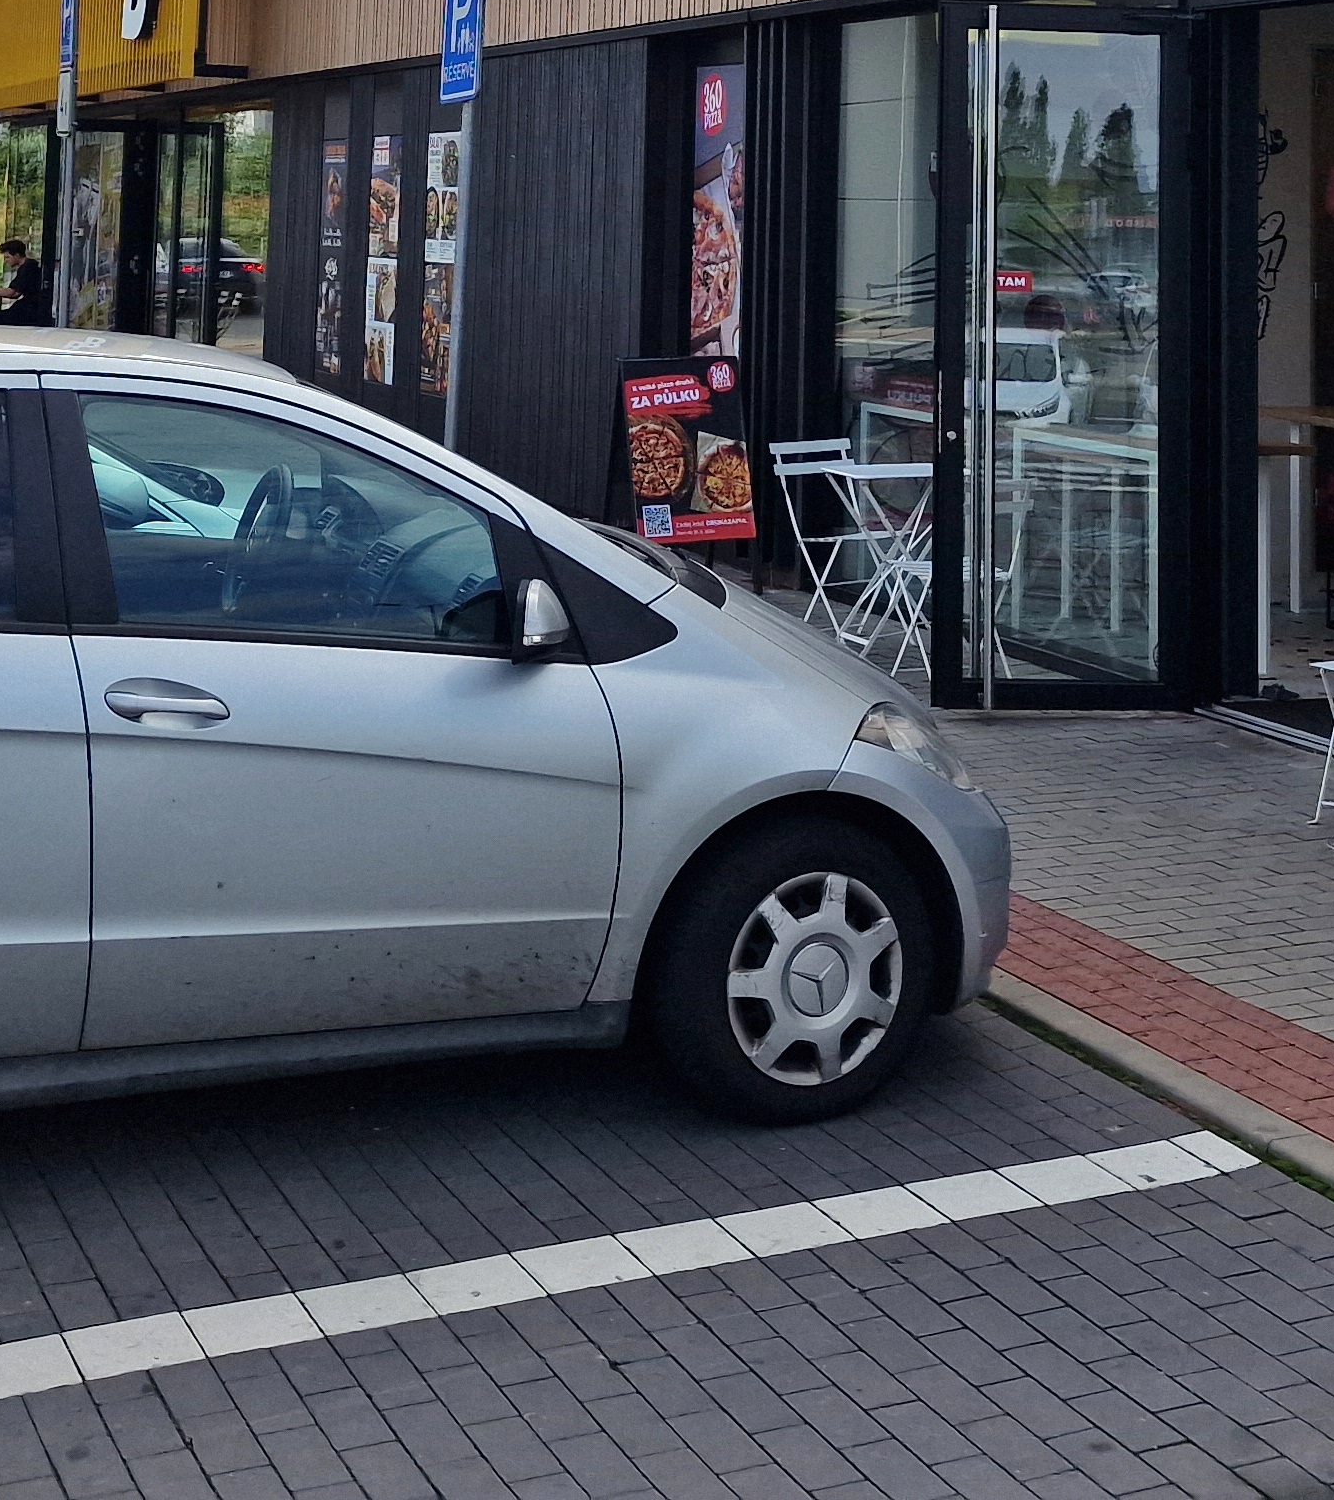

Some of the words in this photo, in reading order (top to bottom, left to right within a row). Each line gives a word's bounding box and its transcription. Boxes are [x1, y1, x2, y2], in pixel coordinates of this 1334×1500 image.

[703, 79, 723, 113] 360
[997, 276, 1026, 287] TAM
[710, 364, 729, 380] 360
[630, 395, 651, 409] ZA
[654, 388, 700, 406] PŮLKU
